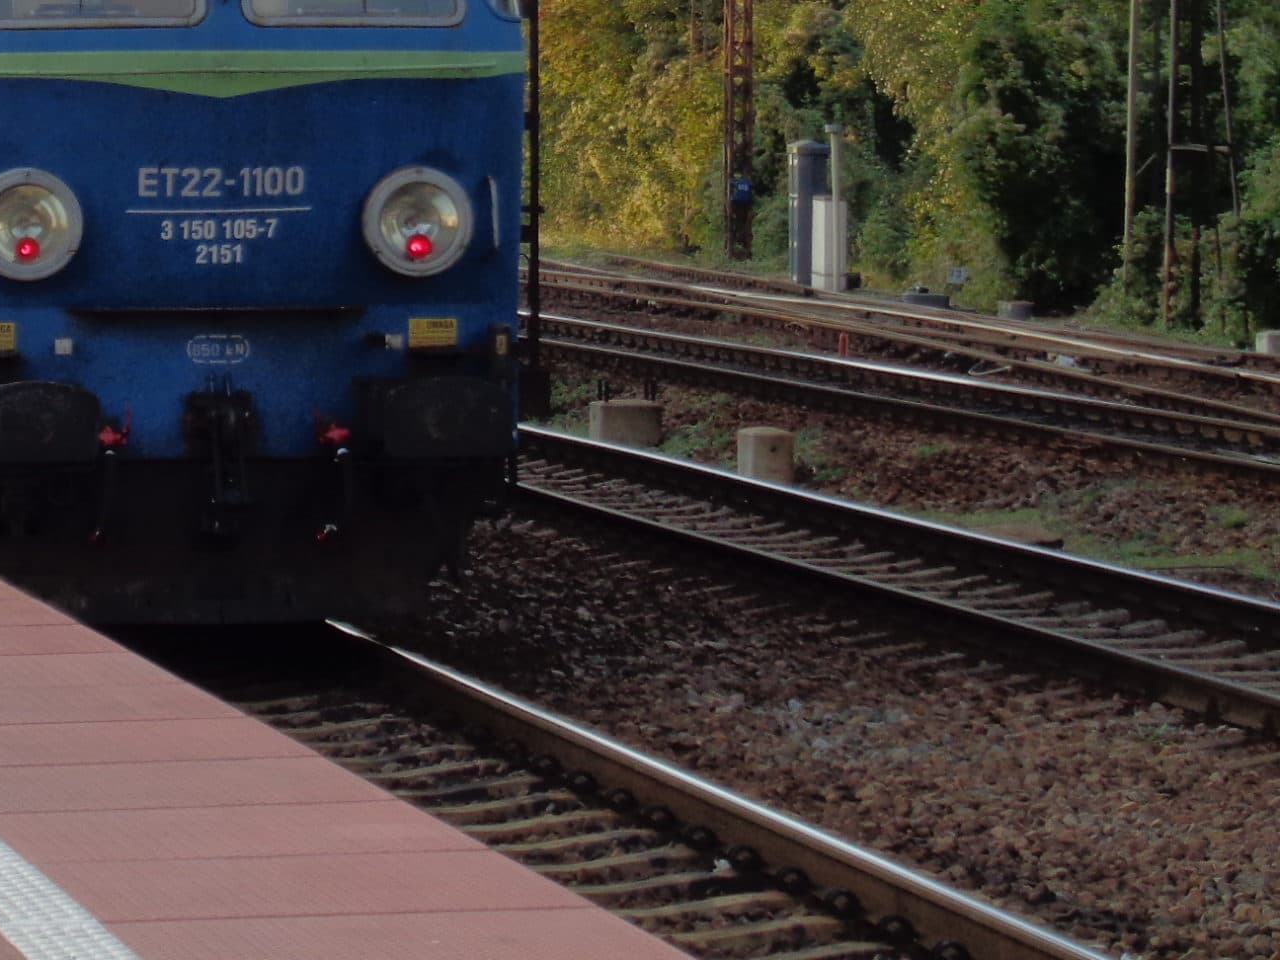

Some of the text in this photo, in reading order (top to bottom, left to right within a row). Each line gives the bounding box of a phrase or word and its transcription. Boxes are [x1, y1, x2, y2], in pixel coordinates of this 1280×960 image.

[138, 167, 305, 196] ET22-1100
[161, 218, 278, 240] 3 150 105-7
[195, 243, 243, 264] 2151
